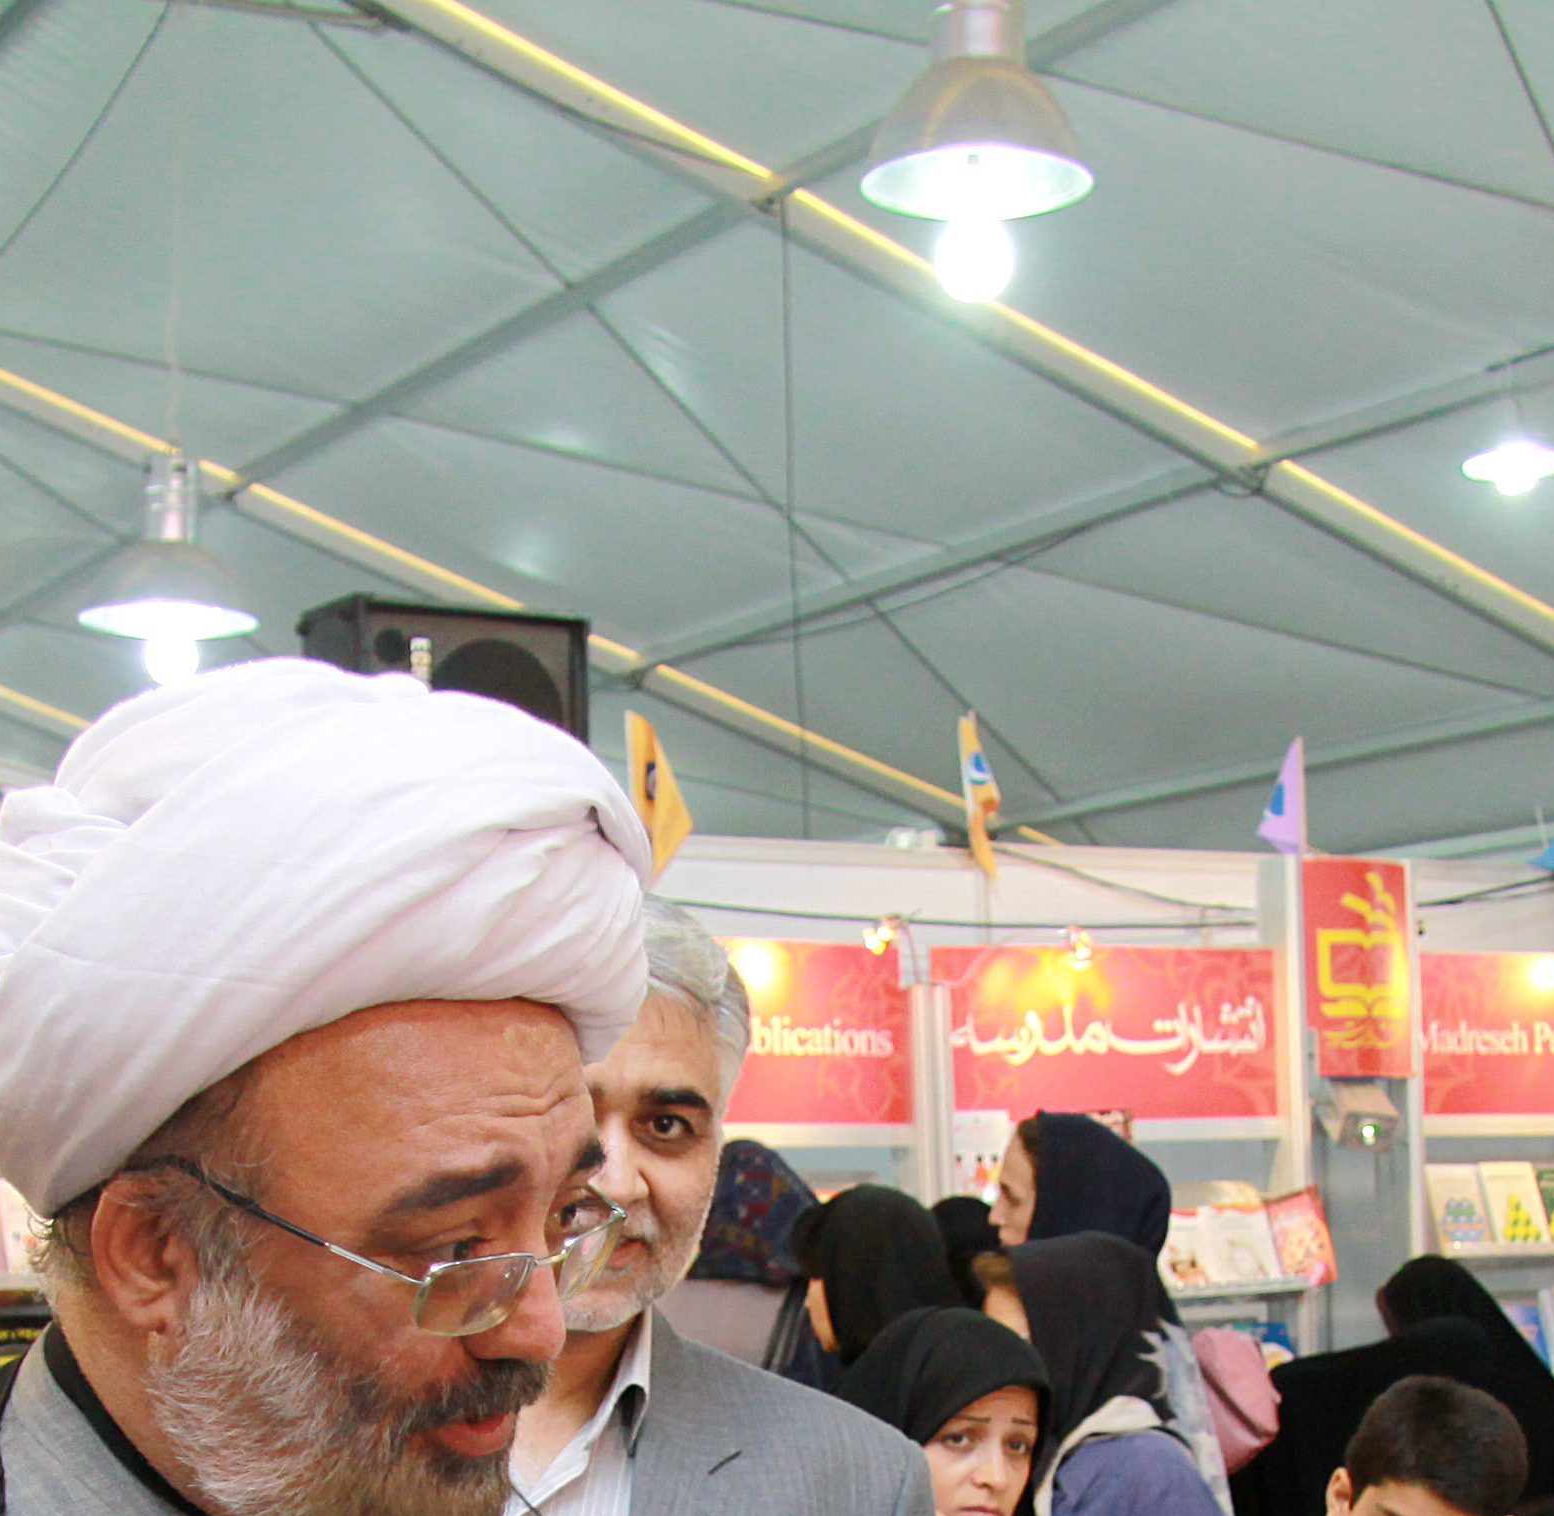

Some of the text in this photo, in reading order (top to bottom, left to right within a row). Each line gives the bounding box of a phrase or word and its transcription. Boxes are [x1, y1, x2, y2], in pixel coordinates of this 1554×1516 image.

[747, 1014, 895, 1058] blications
[951, 995, 1267, 1076] انتشارات مدرسه
